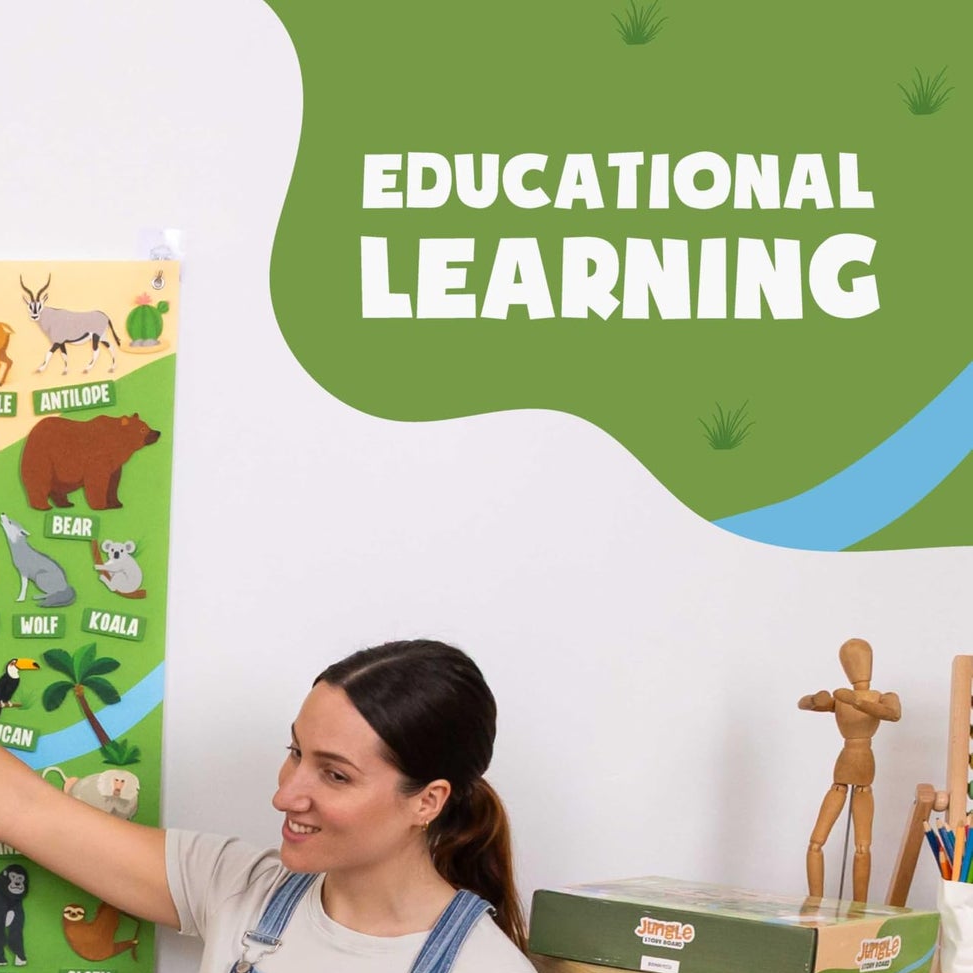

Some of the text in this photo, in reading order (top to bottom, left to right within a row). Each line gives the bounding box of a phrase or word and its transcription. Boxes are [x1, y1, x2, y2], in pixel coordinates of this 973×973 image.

[40, 385, 109, 411] ANTILOPE
[53, 517, 92, 536] BEAR
[21, 617, 58, 634] WOLF
[90, 611, 138, 636] KOALA
